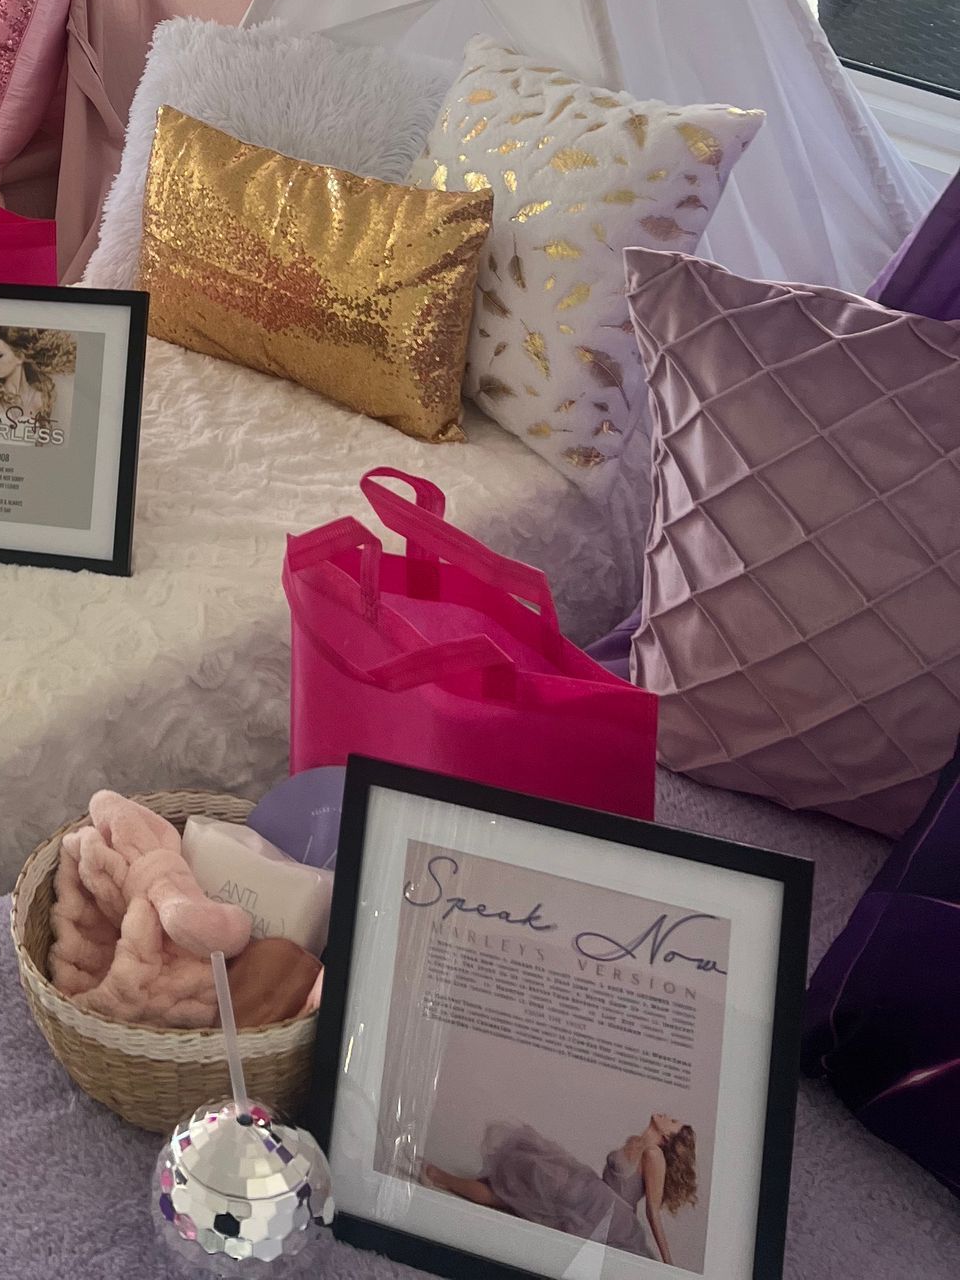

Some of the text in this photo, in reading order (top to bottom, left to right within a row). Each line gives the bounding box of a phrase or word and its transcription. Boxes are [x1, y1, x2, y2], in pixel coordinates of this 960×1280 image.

[5, 405, 59, 435] Swift
[218, 878, 259, 909] ANTI
[403, 856, 728, 976] Speak Now
[577, 958, 697, 1001] VERSION
